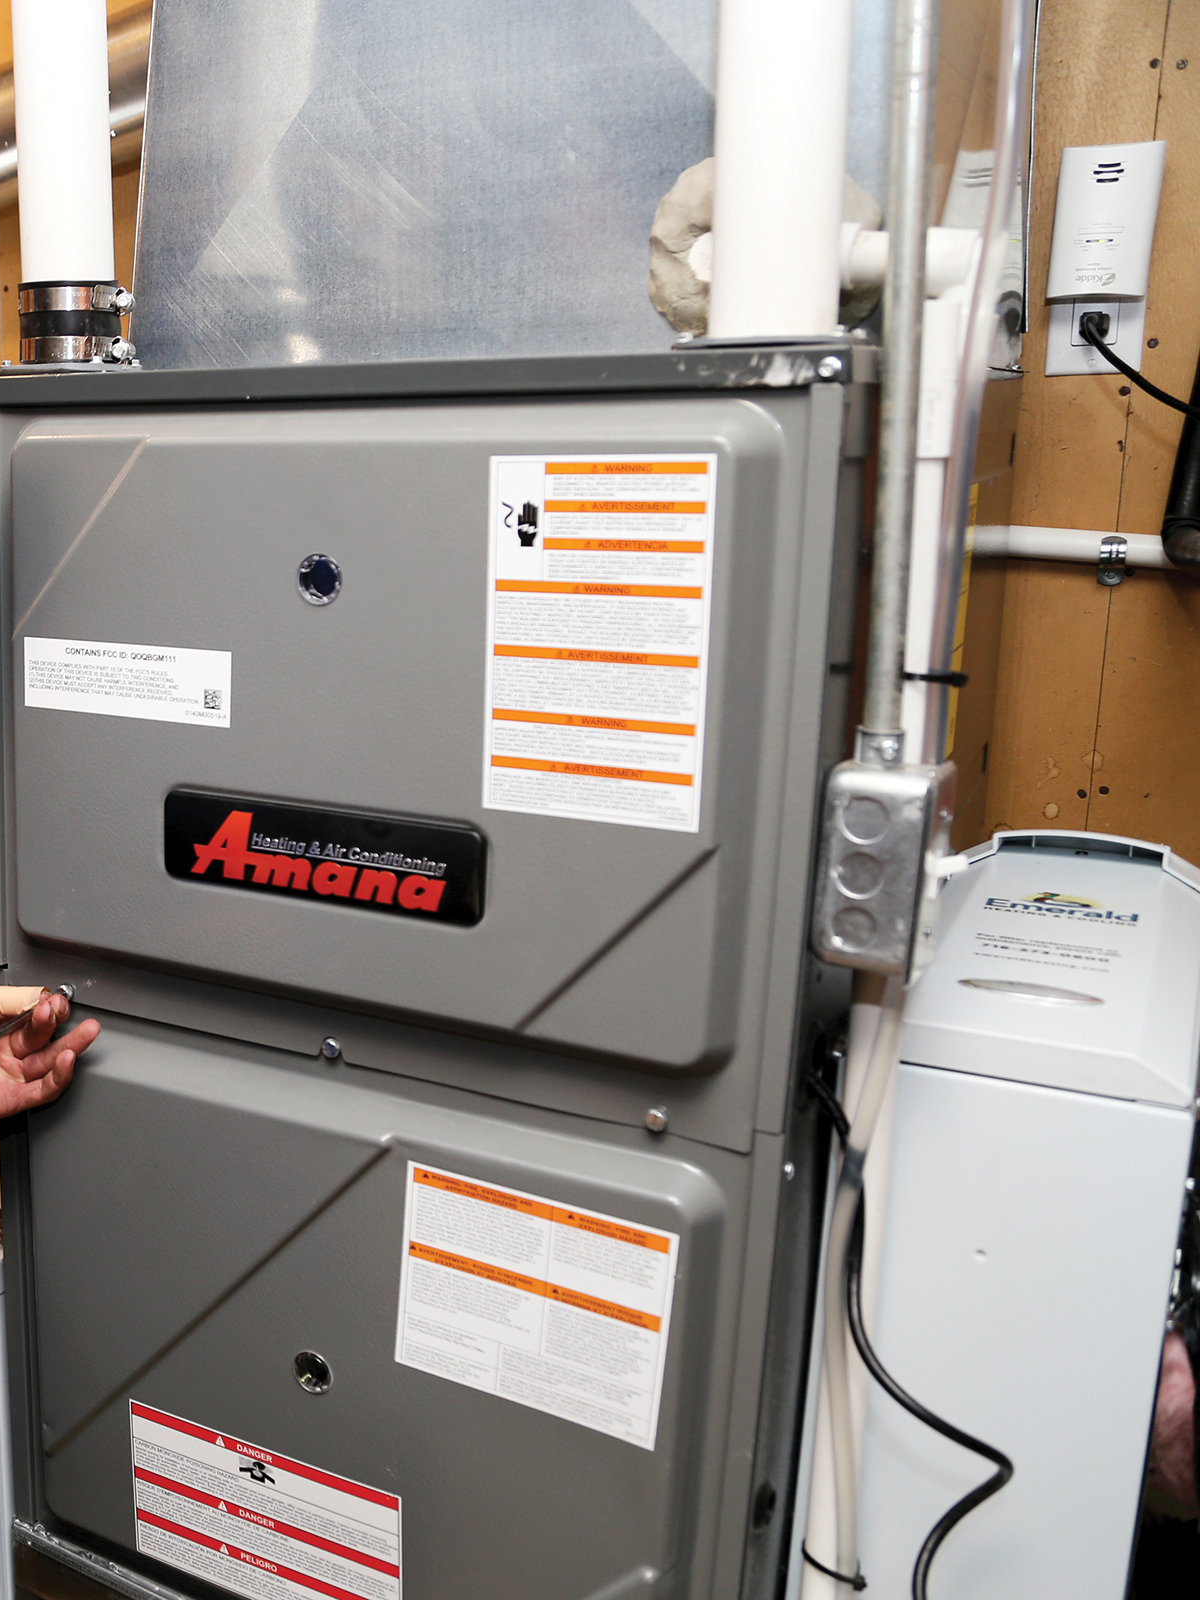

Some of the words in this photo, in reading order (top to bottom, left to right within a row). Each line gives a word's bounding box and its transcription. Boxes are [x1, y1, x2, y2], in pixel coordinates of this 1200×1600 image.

[1076, 274, 1103, 283] Kidde
[605, 464, 653, 473] WARNING
[592, 502, 676, 511] AVERTISSEMENT
[598, 540, 668, 550] ADVERTENCIA
[585, 586, 631, 594] WARNING
[65, 647, 101, 657] CONTAINS
[102, 649, 117, 658] FCC
[119, 651, 128, 659] ID:
[568, 652, 649, 664] AVERTISSEMENT
[103, 677, 126, 685] HARMFUL
[54, 685, 89, 693] INTERFERENCE
[108, 684, 145, 693] INTERFERENCE
[581, 717, 627, 728] WARNING
[564, 764, 644, 779] AVERTISSEMENT
[252, 833, 306, 854] Heating
[308, 841, 320, 855] &
[323, 843, 346, 858] Air
[350, 847, 447, 876] Conditioning
[190, 810, 447, 913] Amana
[985, 897, 1139, 922] Emerald
[236, 1444, 273, 1464] DANGER
[134, 1440, 156, 1453] CARBON
[156, 1447, 186, 1462] MONOXIDE
[186, 1456, 216, 1474] POISONING
[217, 1468, 240, 1482] HAZARD
[137, 1480, 156, 1491] RISQUE
[212, 1507, 220, 1515] AU
[220, 1510, 252, 1528] MONOXYDE
[252, 1524, 261, 1532] DE
[238, 1508, 276, 1528] DANGER
[206, 1549, 218, 1558] POR
[249, 1566, 257, 1574] DE
[240, 1552, 278, 1573] PELIGRO
